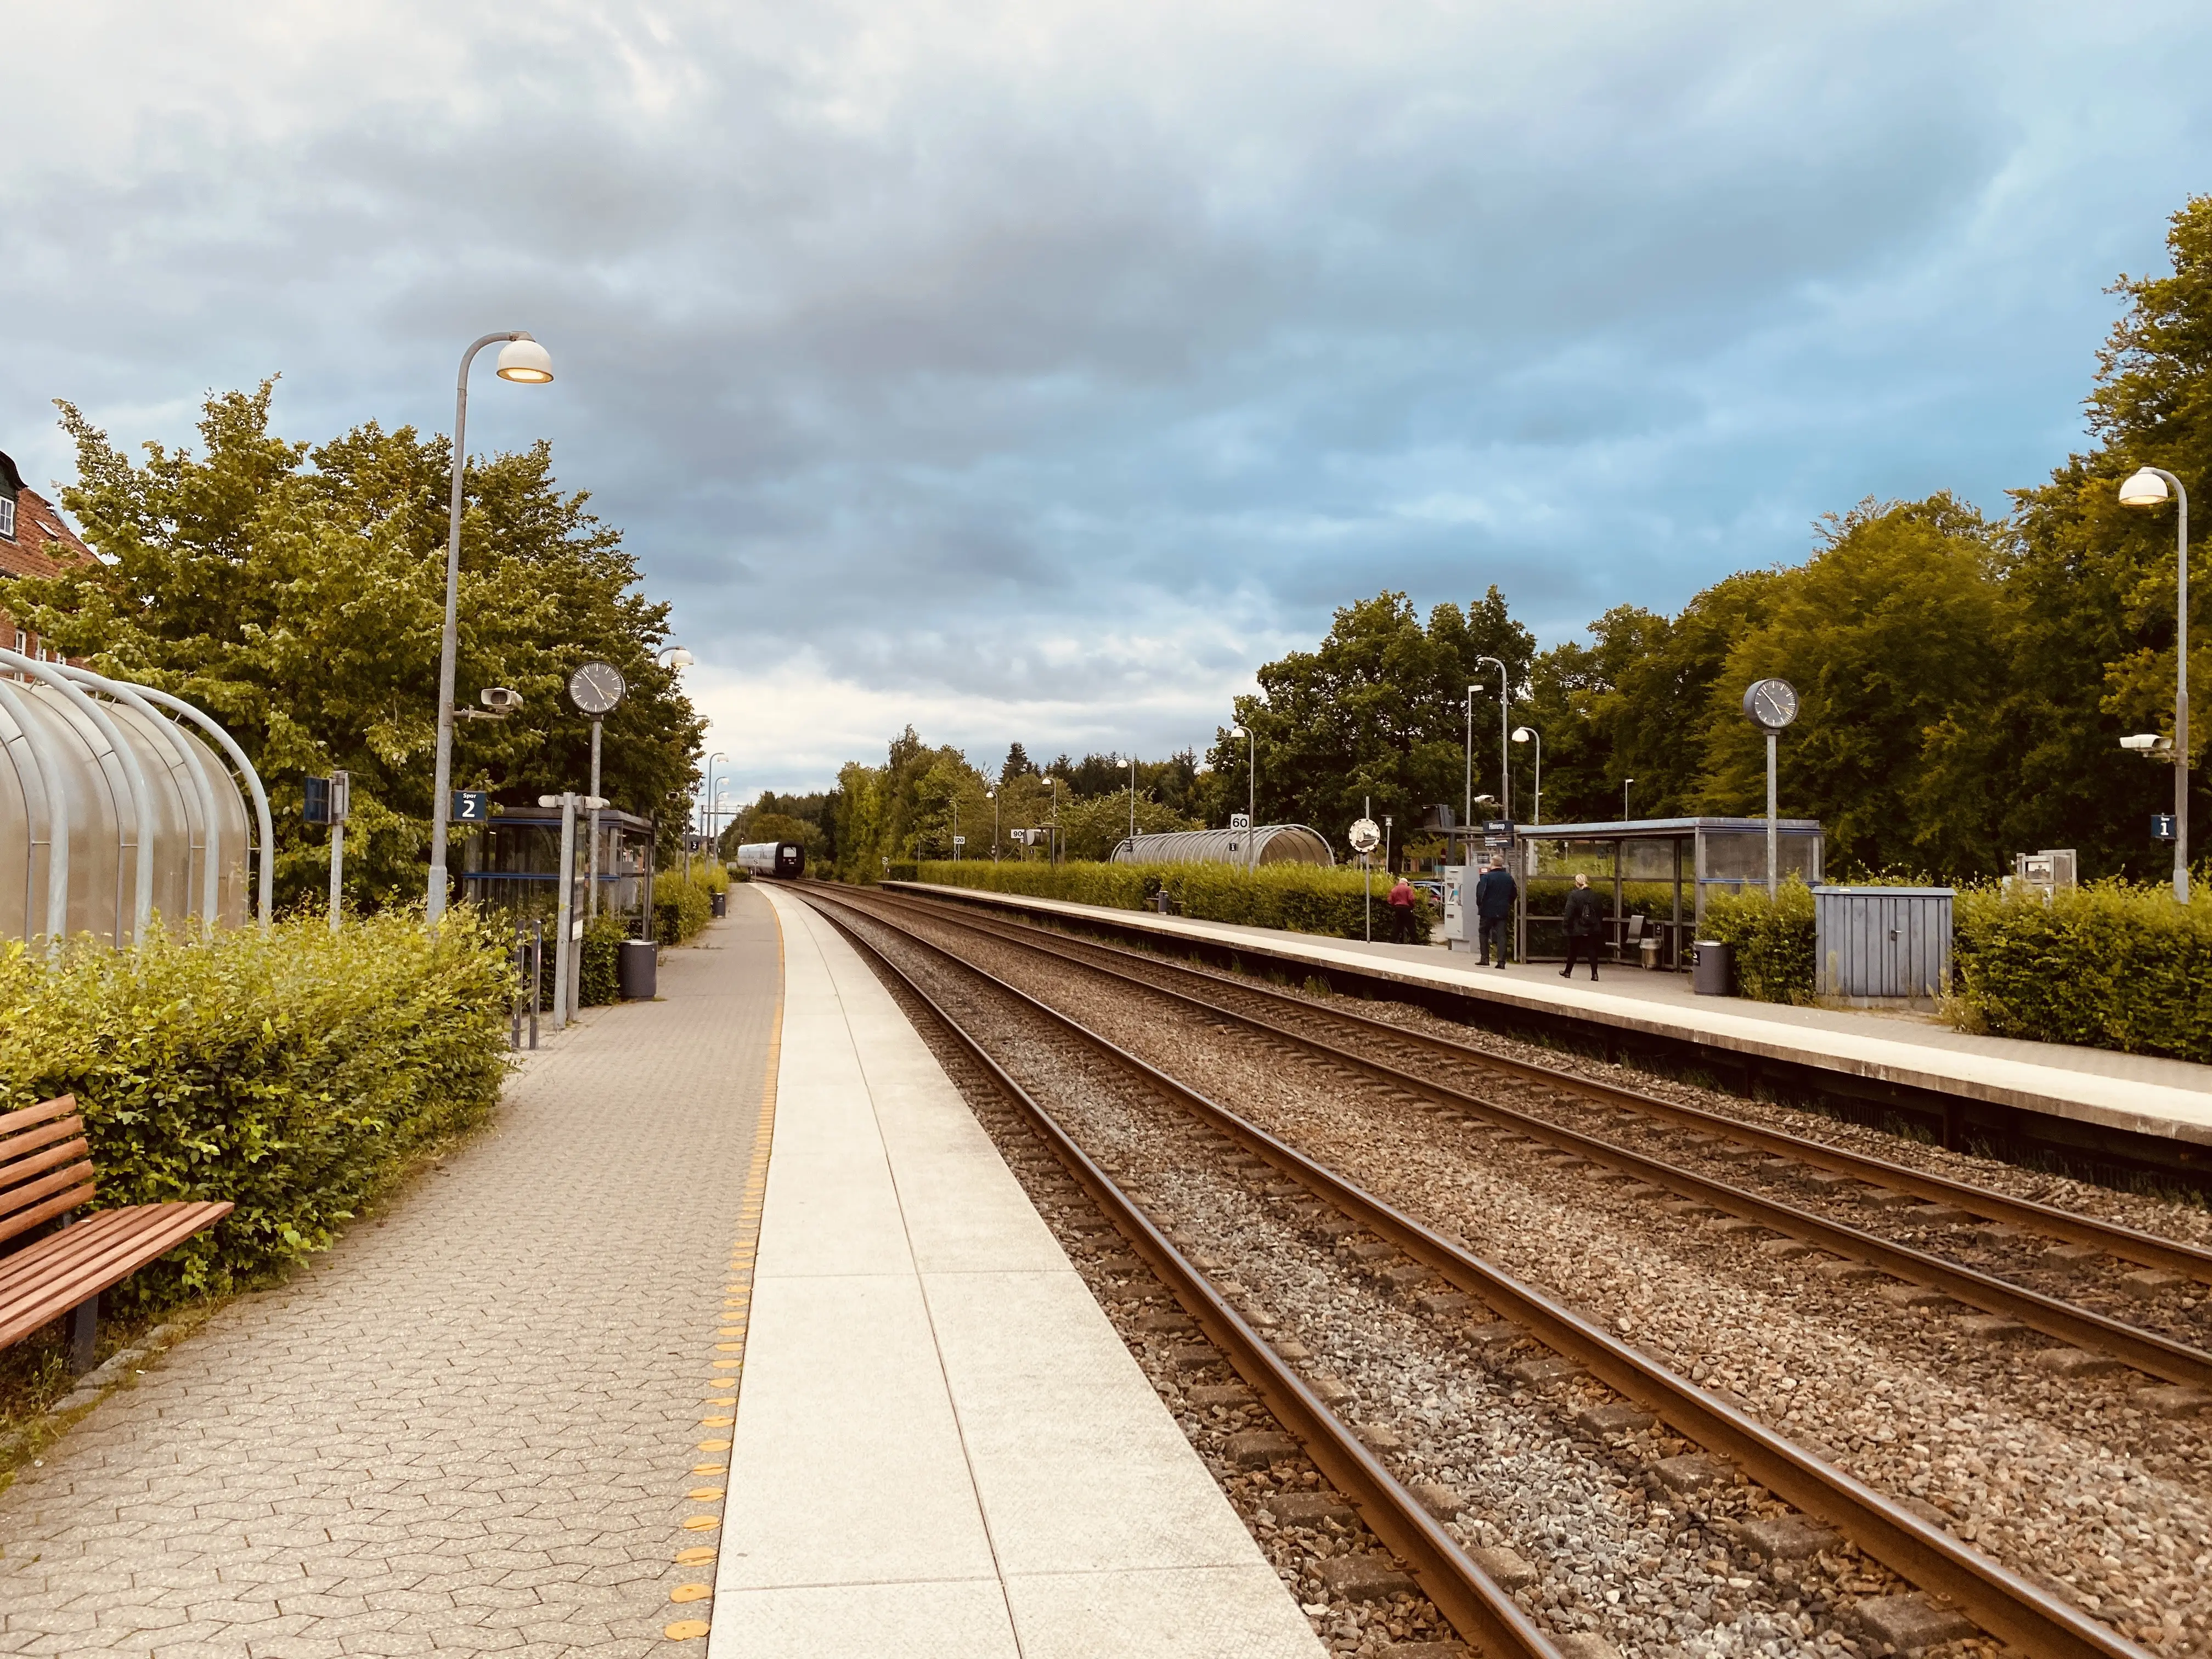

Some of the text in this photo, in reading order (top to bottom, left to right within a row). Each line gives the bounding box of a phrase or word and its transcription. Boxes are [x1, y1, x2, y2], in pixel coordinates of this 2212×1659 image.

[462, 800, 475, 817] 2
[1233, 817, 1248, 827] 60
[2160, 822, 2169, 836] 1
